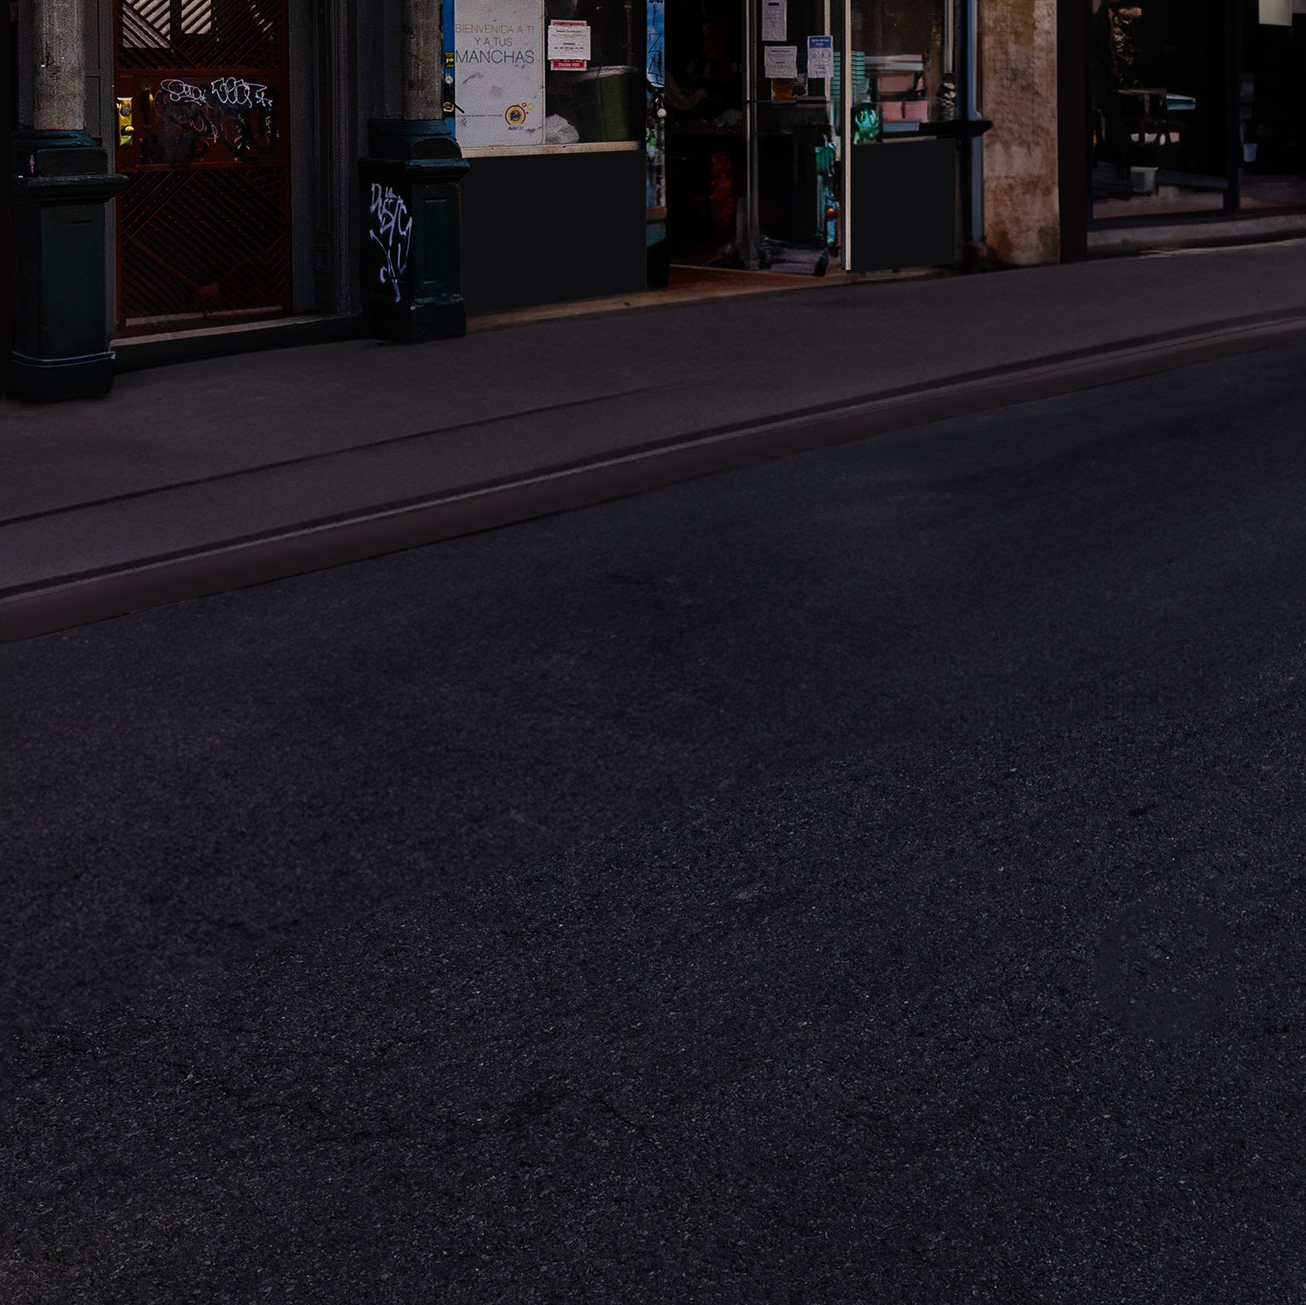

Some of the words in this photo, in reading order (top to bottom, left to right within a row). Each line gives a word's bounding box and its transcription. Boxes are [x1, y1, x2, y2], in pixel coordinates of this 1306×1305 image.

[455, 24, 513, 34] BIENVENIDA
[516, 25, 524, 33] A
[527, 25, 534, 33] TI
[474, 37, 480, 46] Y
[484, 37, 490, 46] A
[493, 37, 512, 47] TUS
[455, 49, 535, 64] MANCHAS
